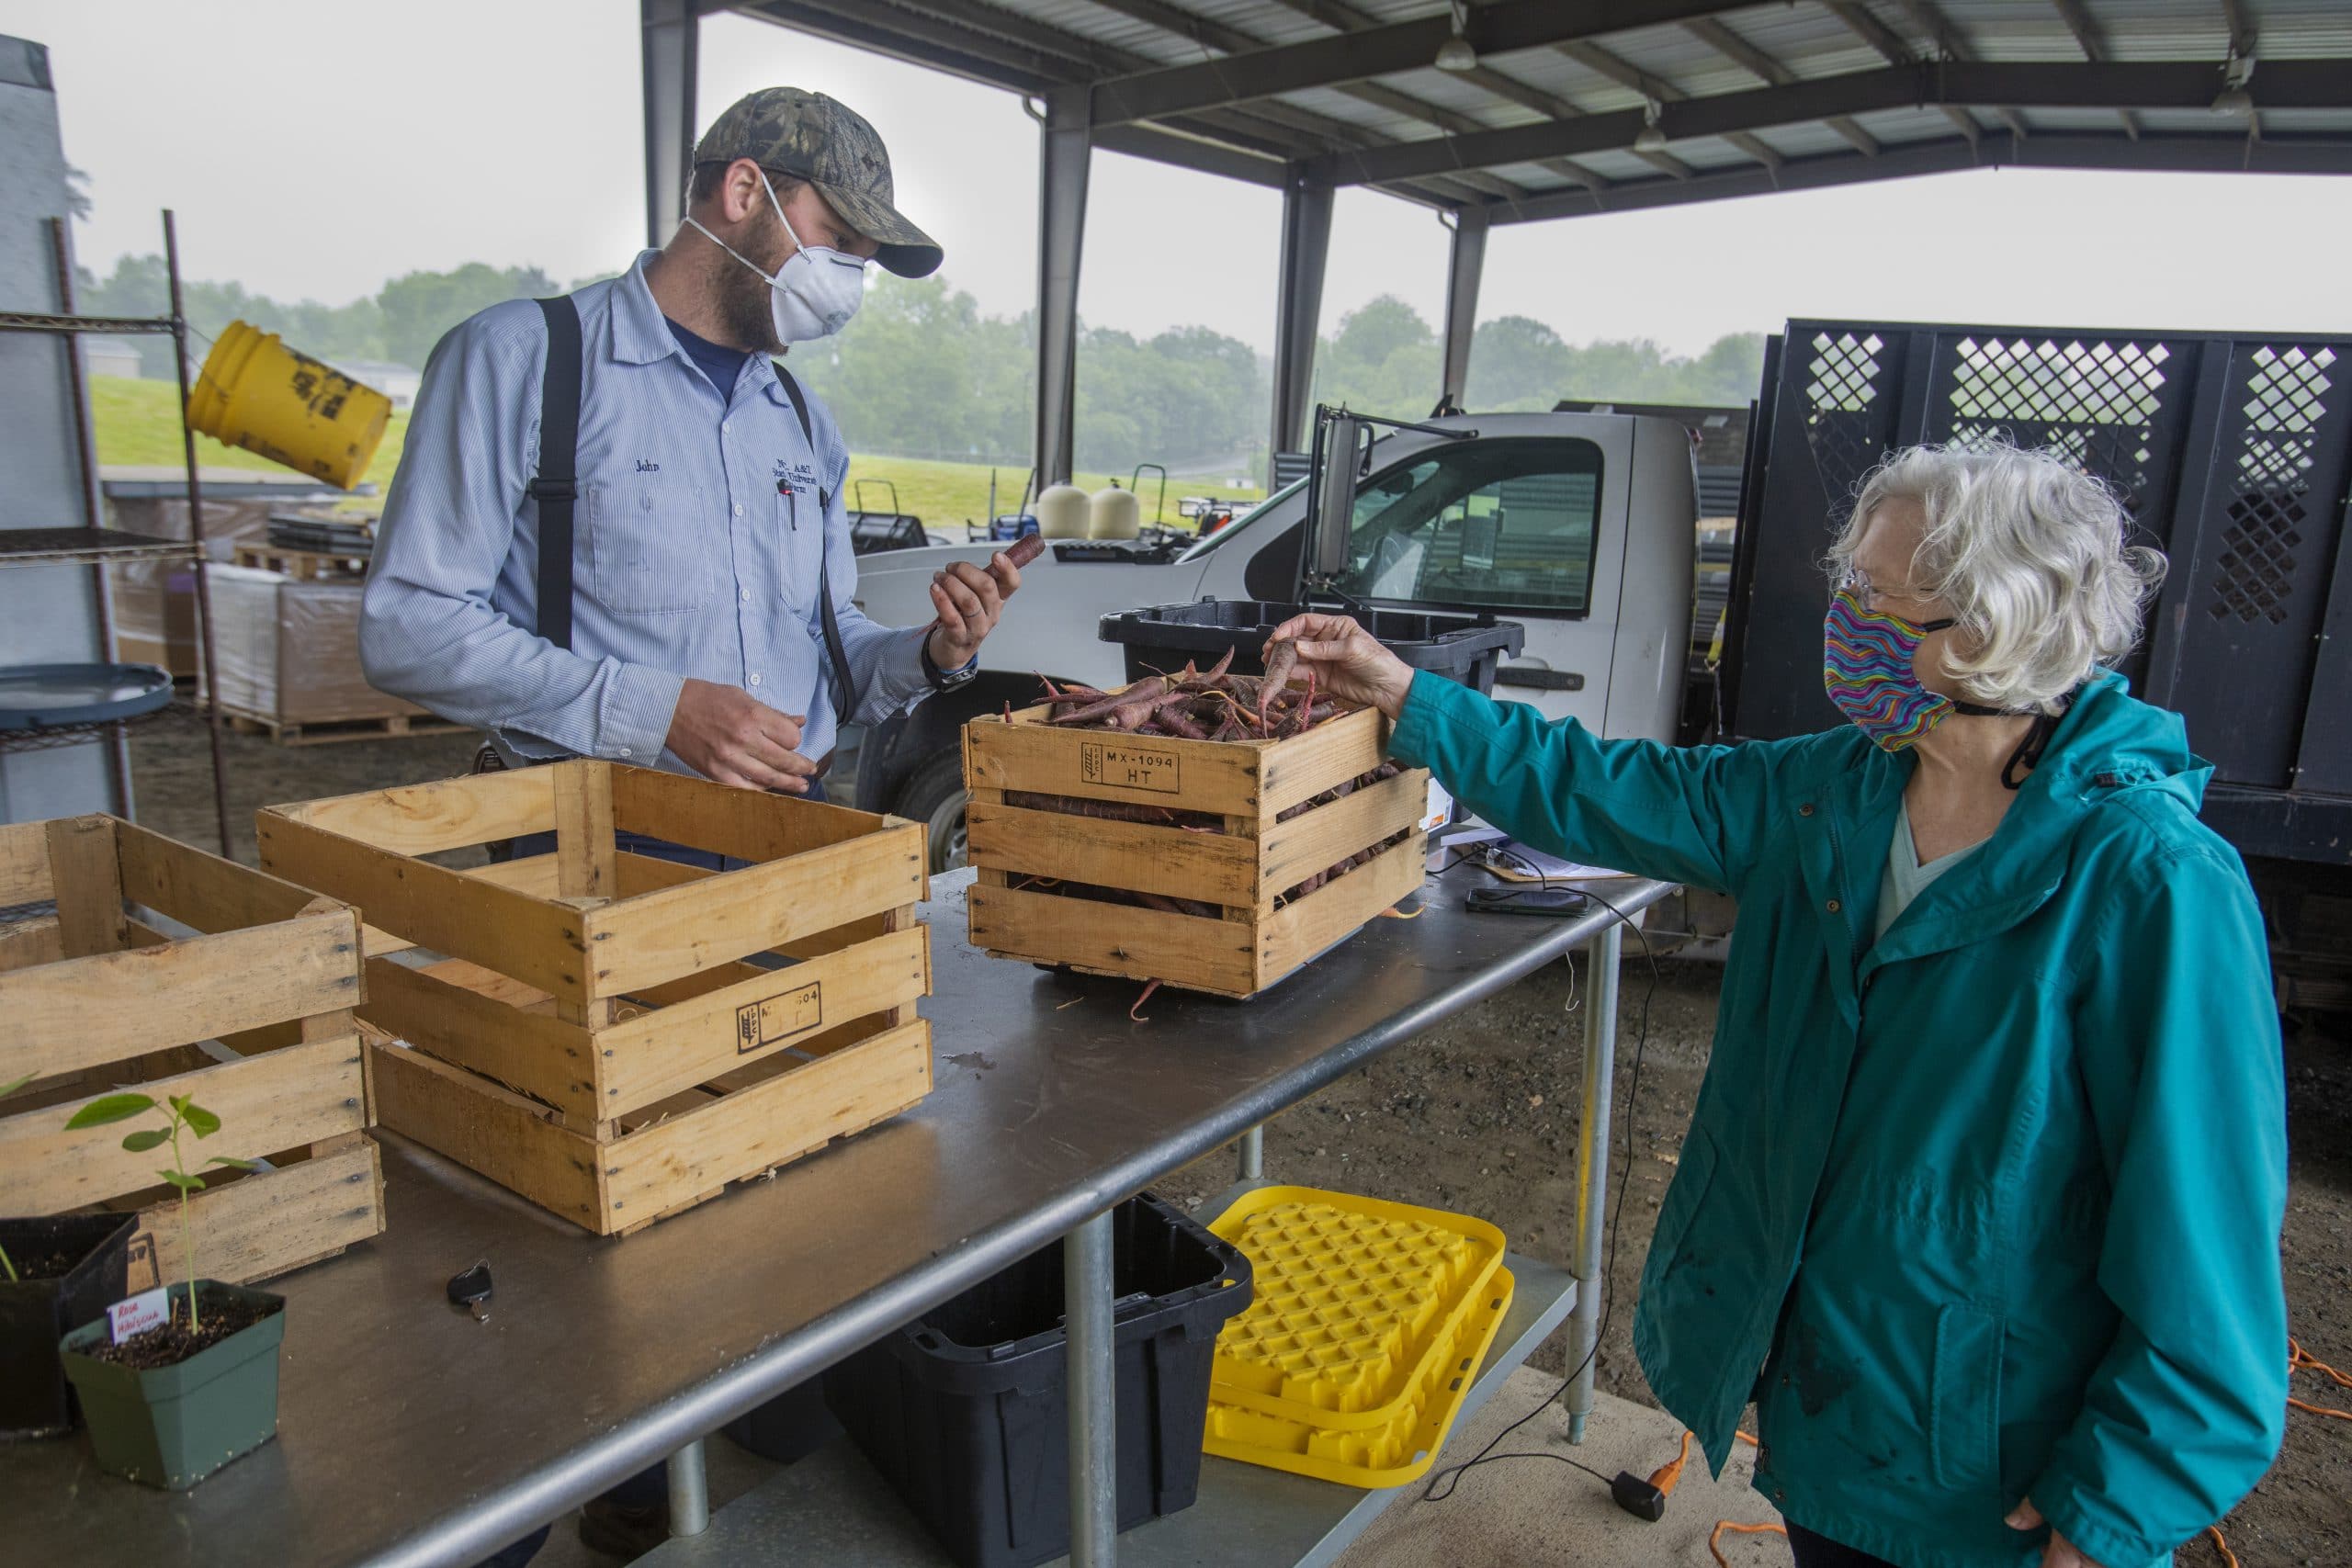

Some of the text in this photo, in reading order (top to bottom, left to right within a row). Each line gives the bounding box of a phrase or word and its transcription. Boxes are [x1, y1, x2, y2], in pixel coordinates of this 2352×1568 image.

[636, 459, 660, 472] John
[1107, 751, 1172, 768] MX-1094
[1128, 769, 1151, 784] HT
